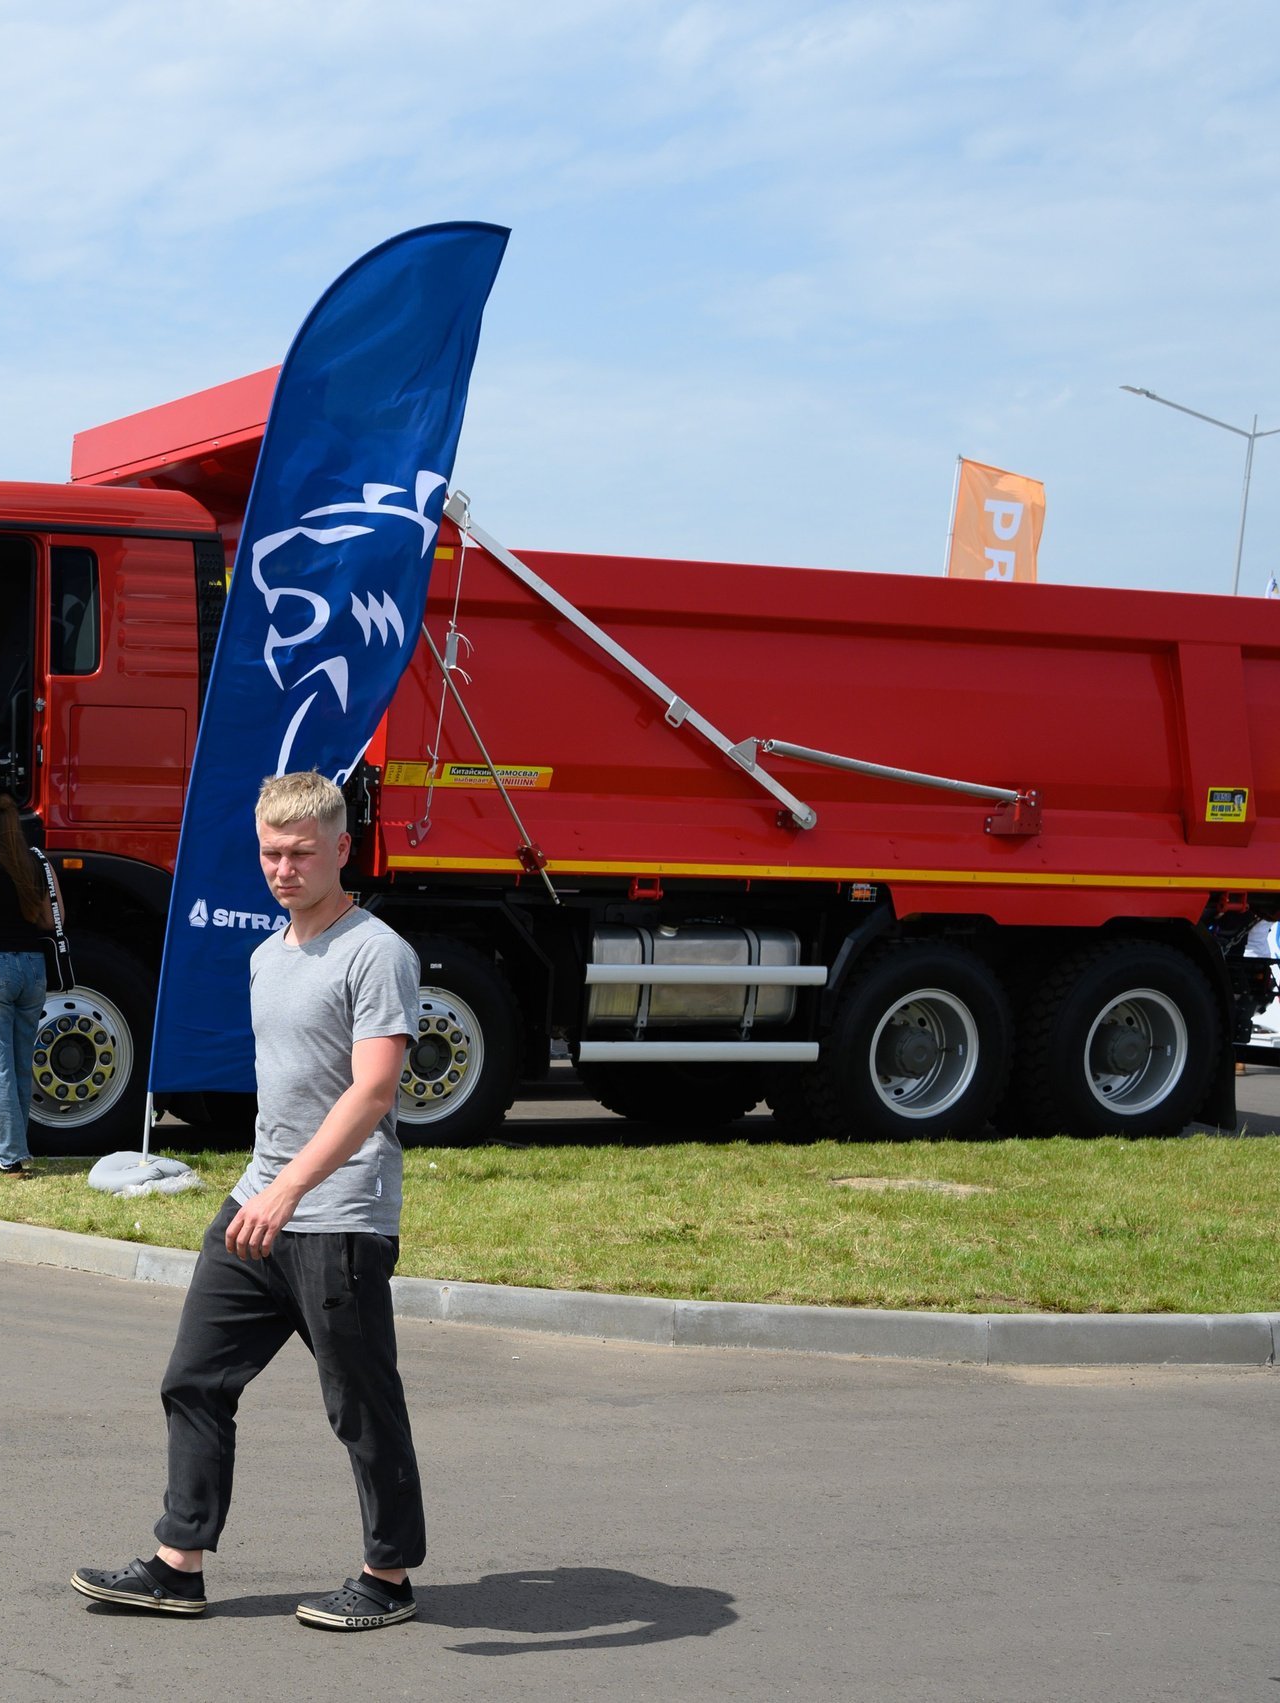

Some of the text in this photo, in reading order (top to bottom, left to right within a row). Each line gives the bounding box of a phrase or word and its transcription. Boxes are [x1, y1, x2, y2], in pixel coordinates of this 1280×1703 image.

[496, 769, 538, 777] самосвал
[43, 862, 56, 897] PINEAPPLE
[52, 901, 63, 937] PINEAPPLE
[212, 908, 289, 930] SITRA
[345, 1616, 385, 1627] crocs
